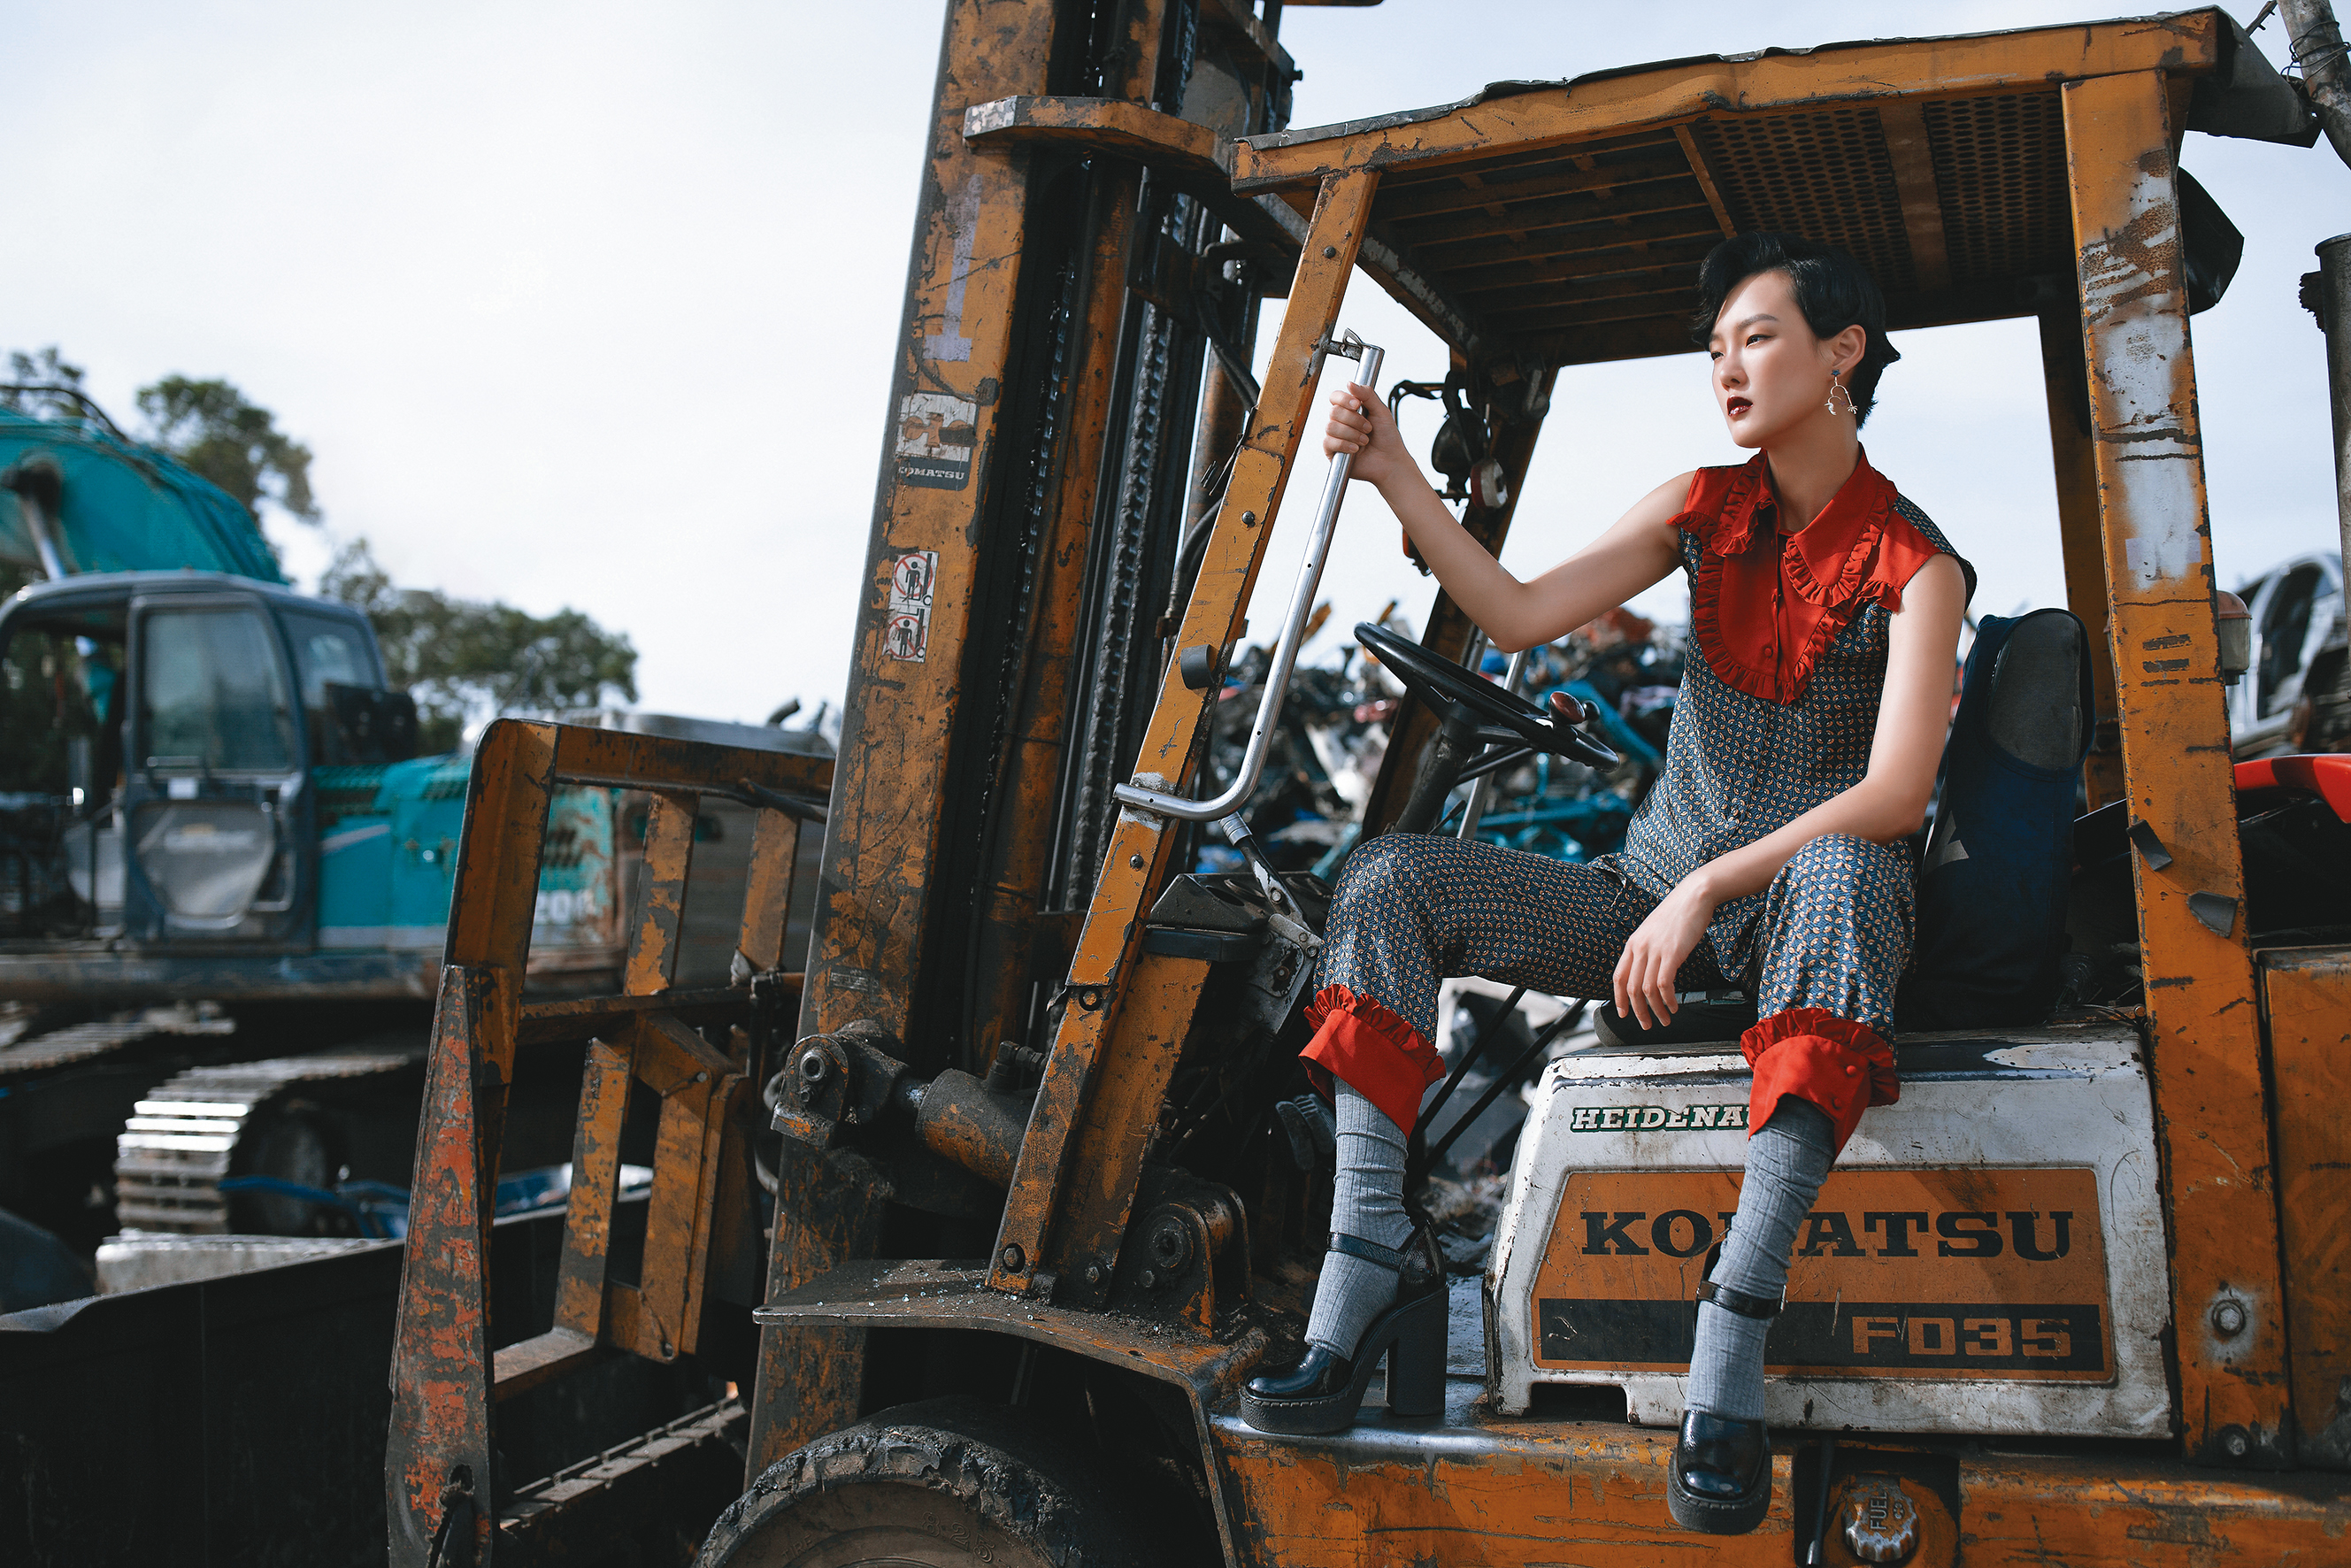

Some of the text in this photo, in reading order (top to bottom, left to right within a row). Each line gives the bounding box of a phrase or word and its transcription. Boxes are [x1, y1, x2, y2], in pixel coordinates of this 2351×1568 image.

[1571, 1106, 1749, 1131] HEIDENA
[1580, 1209, 2074, 1262] KOATSU
[1852, 1316, 2071, 1357] FD35
[1870, 1491, 1888, 1530] FUEL
